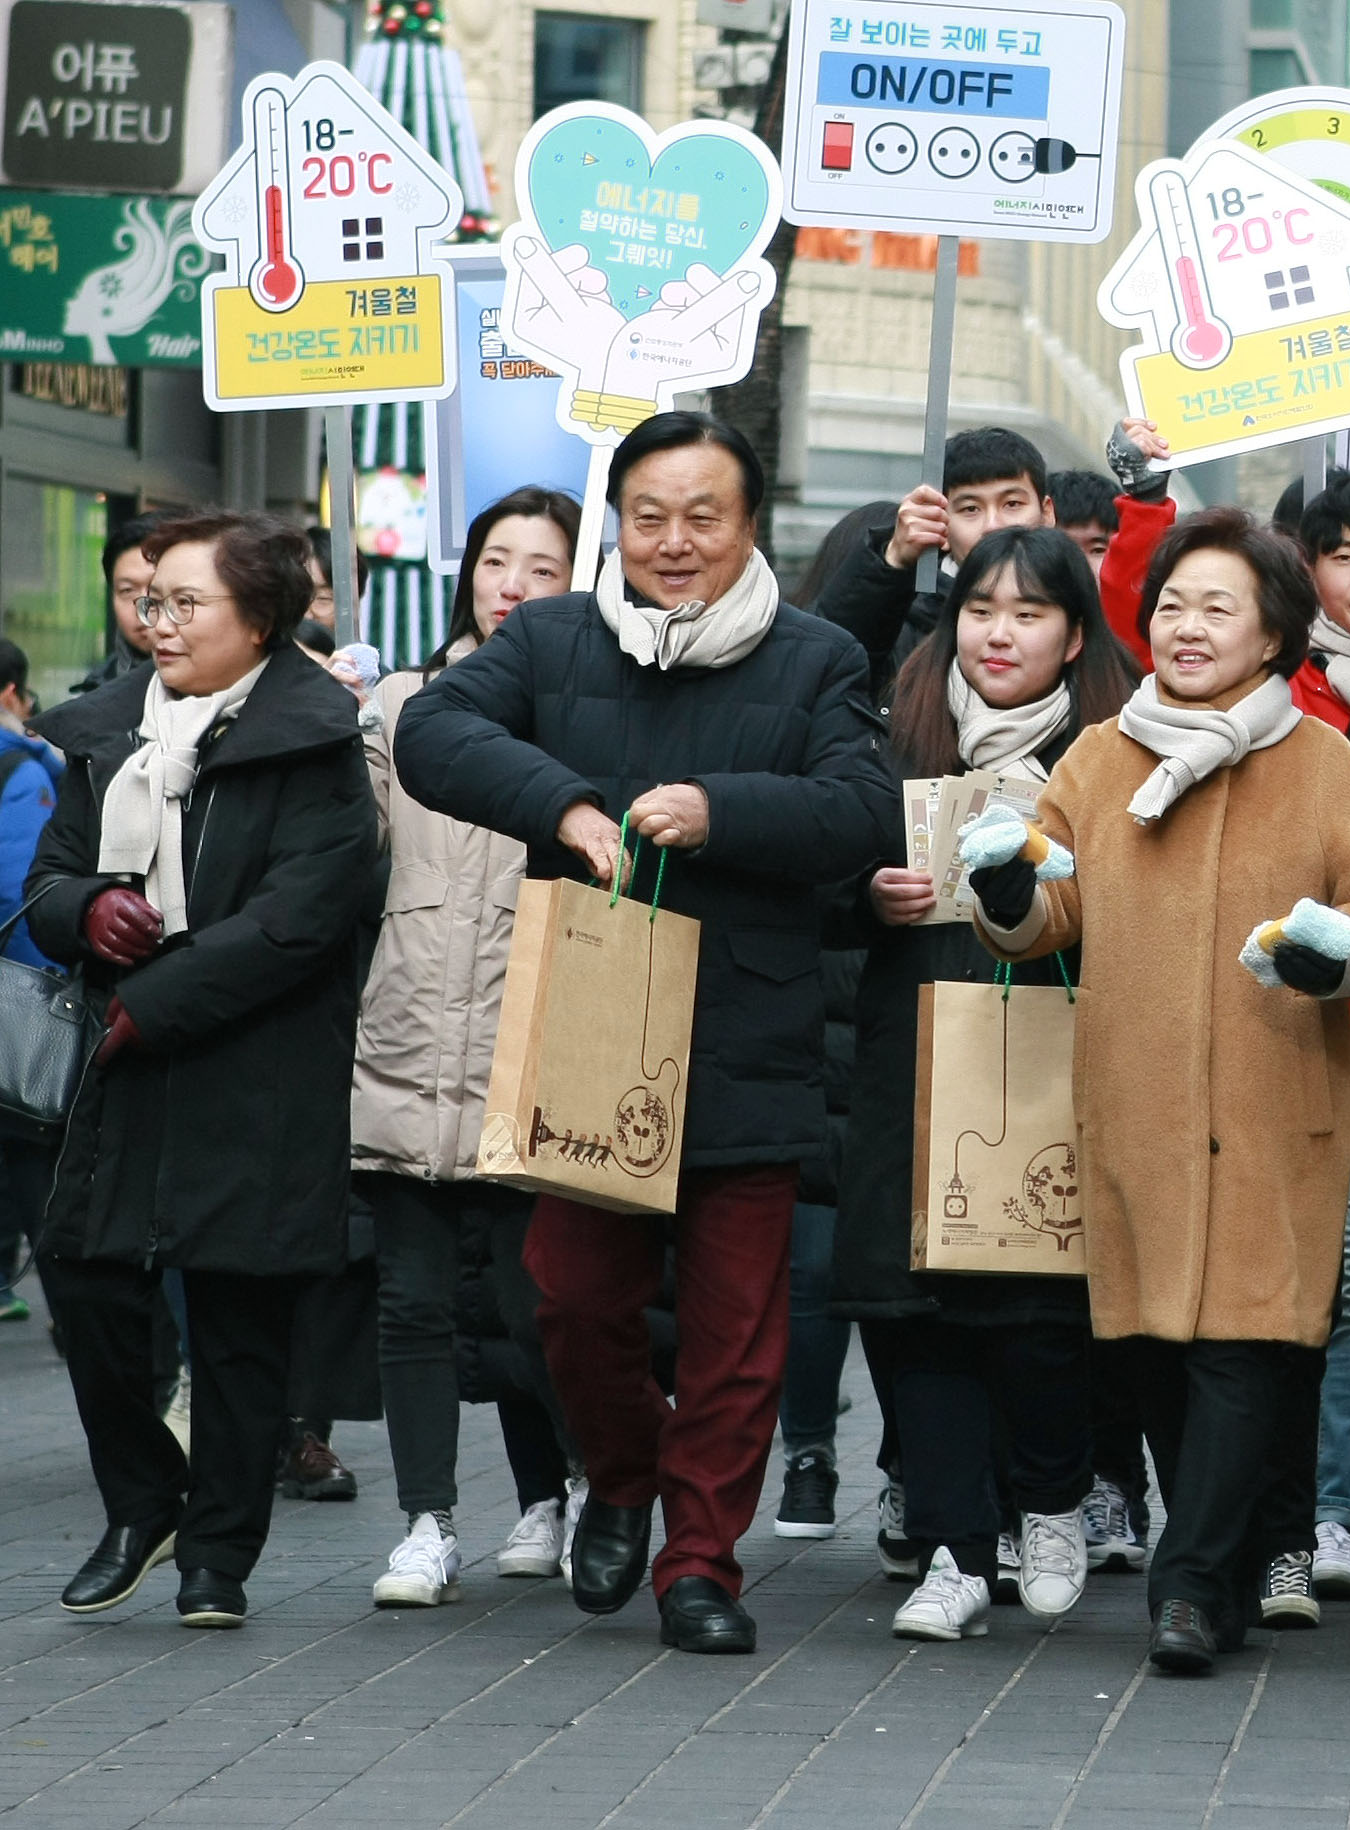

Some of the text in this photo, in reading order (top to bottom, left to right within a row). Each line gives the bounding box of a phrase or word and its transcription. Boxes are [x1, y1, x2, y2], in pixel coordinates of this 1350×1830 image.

[829, 16, 1042, 56] 잘 보이는 곳에 두고
[53, 41, 140, 93] 어퓨
[851, 63, 1013, 108] ON/OFF
[17, 97, 172, 145] A'PIEU
[301, 118, 354, 152] 18-
[1327, 117, 1340, 135] 3
[1251, 129, 1268, 148] 2
[597, 181, 700, 222] 에너지를
[993, 199, 1084, 220] 에너지시민연대
[1206, 187, 1265, 221] 18-
[579, 209, 657, 241] 절약하는
[345, 286, 416, 317] 겨울철
[147, 334, 200, 358] Hair
[246, 324, 419, 363] 건강온도 지키기
[481, 361, 497, 380] 꼭
[1178, 374, 1284, 423] 건강온도
